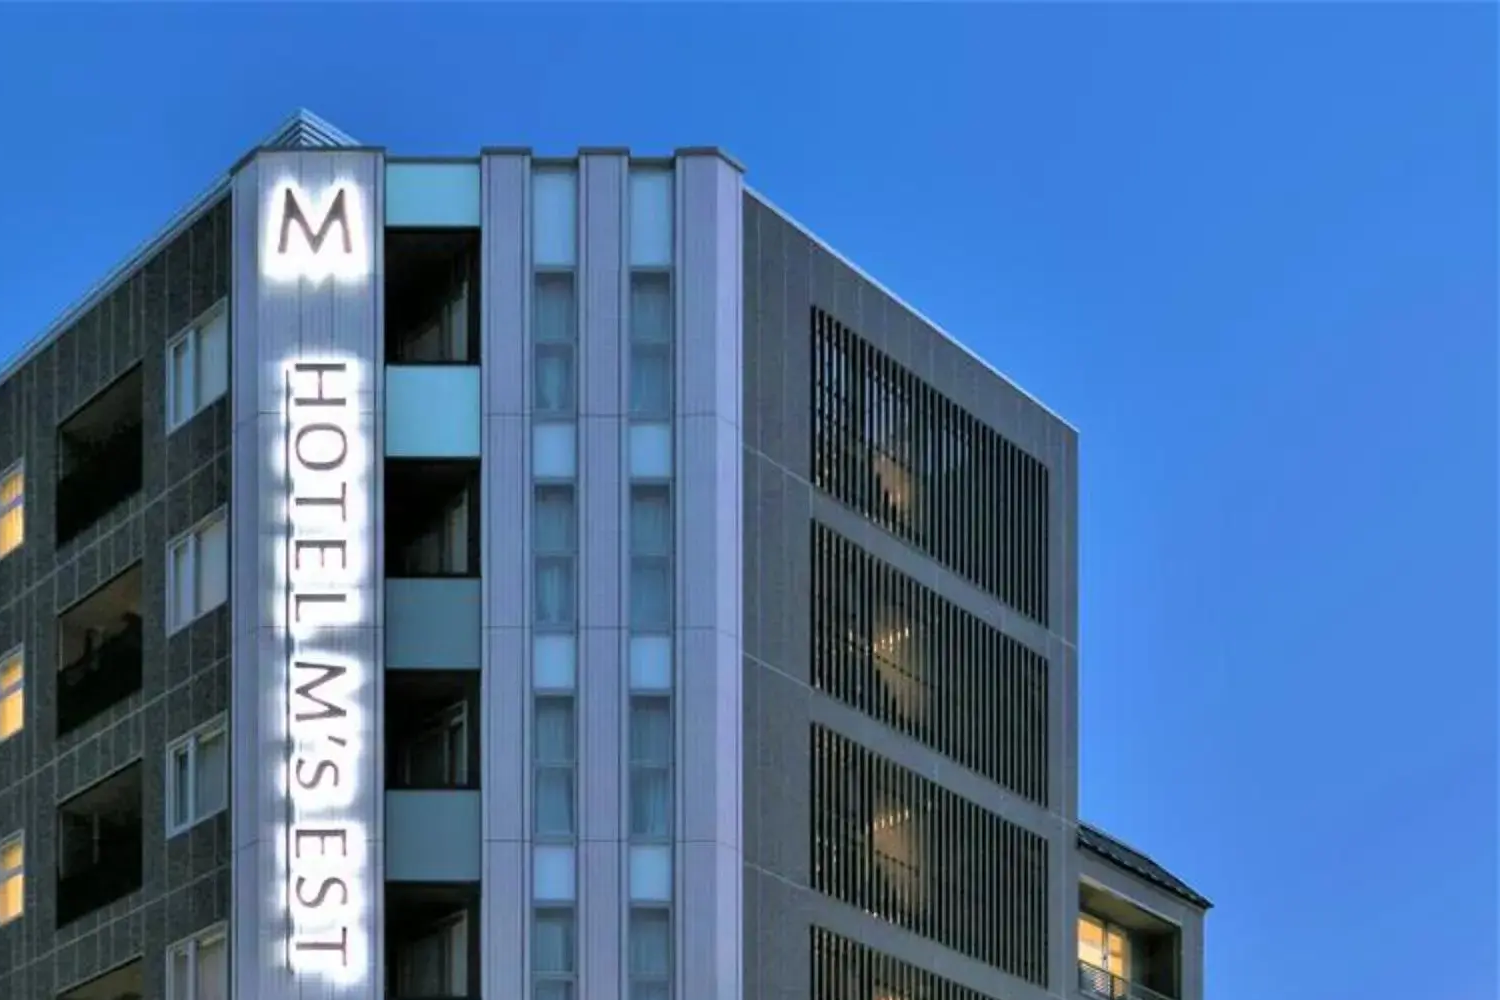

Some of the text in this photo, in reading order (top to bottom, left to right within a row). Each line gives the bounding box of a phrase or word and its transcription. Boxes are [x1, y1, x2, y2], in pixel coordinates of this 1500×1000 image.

[277, 187, 352, 254] M
[294, 362, 348, 968] HOTEL M'S EST
